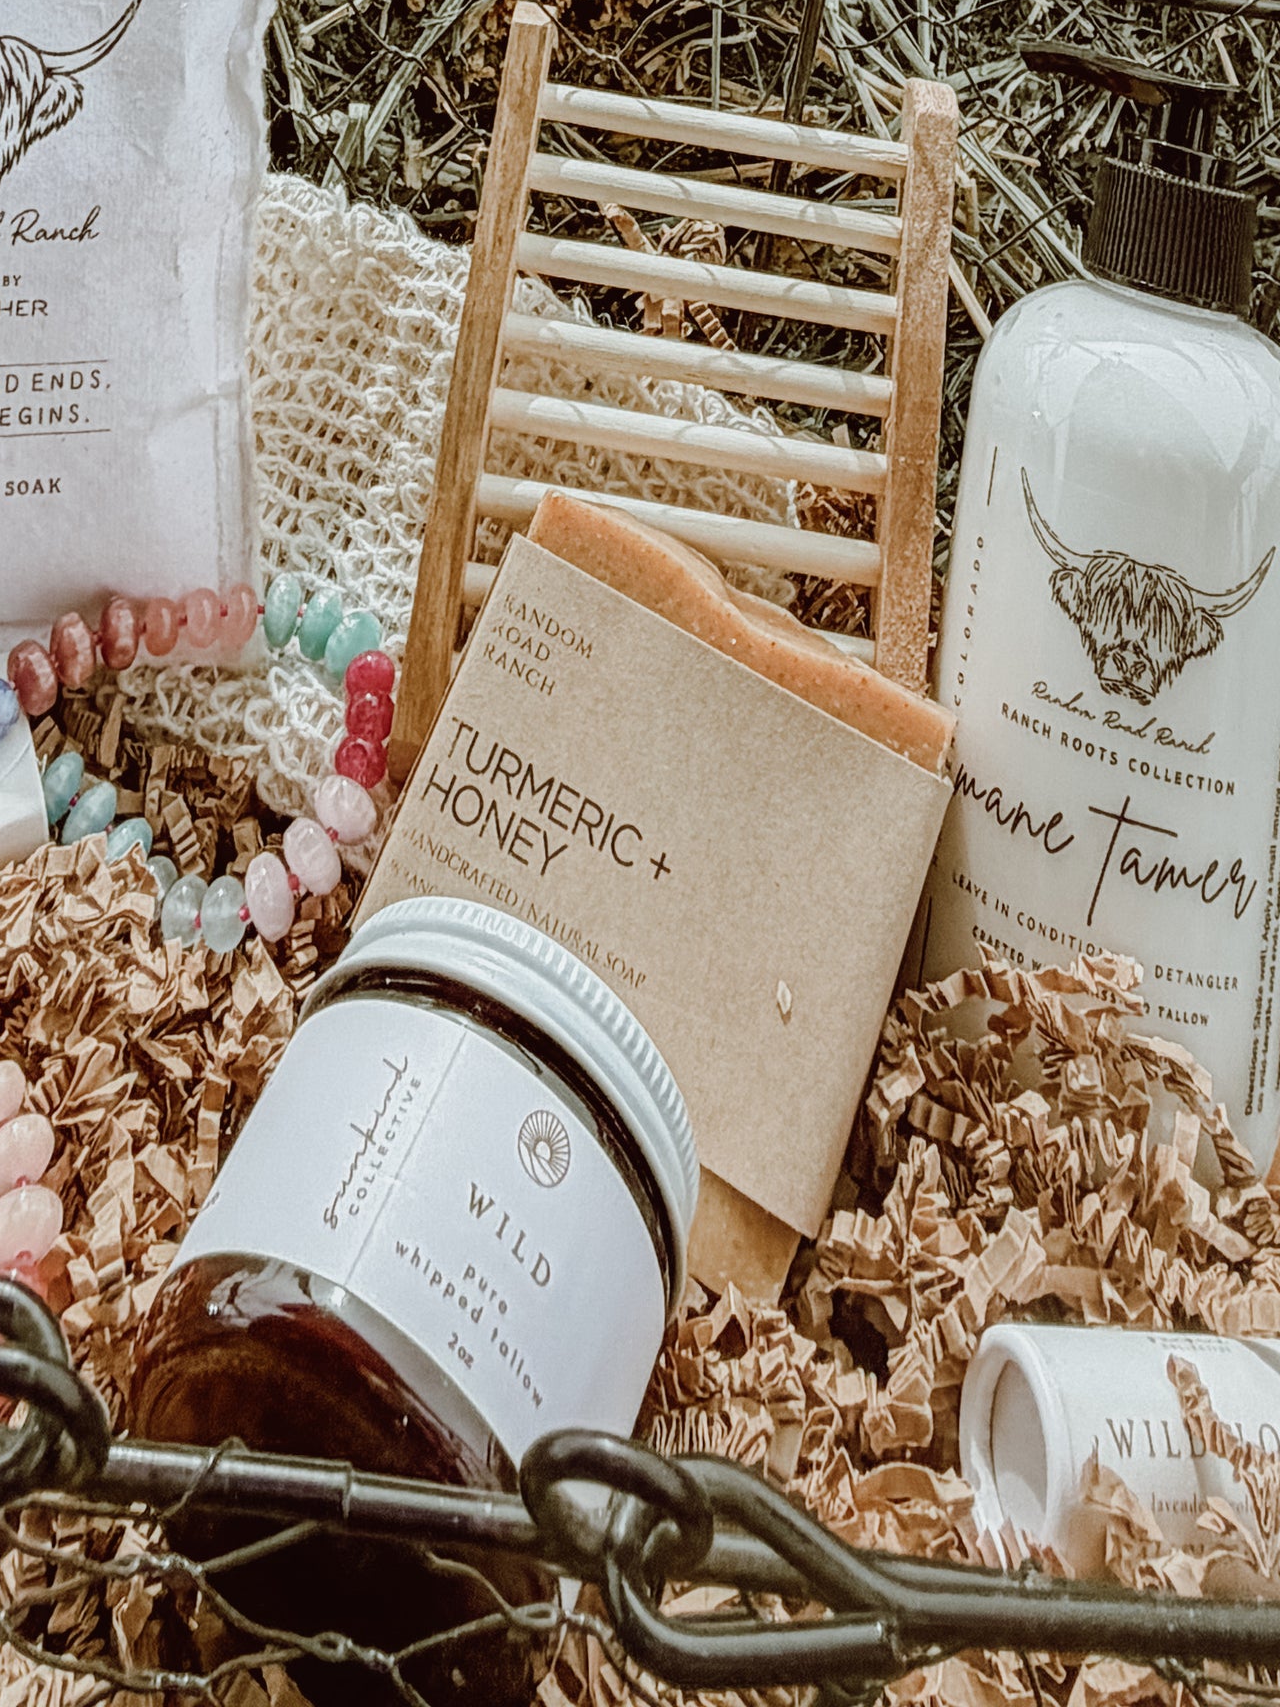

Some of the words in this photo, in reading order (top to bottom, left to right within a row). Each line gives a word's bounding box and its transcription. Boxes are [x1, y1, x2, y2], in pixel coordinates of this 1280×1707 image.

[10, 205, 102, 246] Ranch
[2, 274, 22, 287] BY
[4, 477, 63, 496] SOAK
[953, 536, 985, 708] COLORADO
[484, 643, 556, 696] RANCH
[1001, 702, 1051, 739] RANCH
[1060, 731, 1118, 766] ROOTS
[1128, 757, 1235, 795] COLLECTION
[1031, 681, 1096, 720] Random
[1102, 710, 1157, 739] Road
[1154, 726, 1216, 755] Ranch
[421, 763, 568, 877] HONEY
[446, 716, 643, 868] TURMERIC
[649, 852, 671, 880] +
[526, 902, 602, 963] NATURAL
[602, 950, 647, 989] SOAP
[952, 872, 987, 906] LEAVE
[994, 899, 1009, 918] IN
[1016, 911, 1106, 957] CONDITIO
[1154, 964, 1239, 990] DETANGLER
[972, 924, 1025, 964] CRAFTED
[1158, 1005, 1209, 1026] TALLOW
[348, 1077, 421, 1216] COLLECTIVE
[469, 1182, 552, 1288] WILD
[395, 1240, 483, 1325] whipped
[490, 1326, 544, 1410] tallow
[463, 1263, 508, 1315] pure
[1151, 1491, 1210, 1513] lavende
